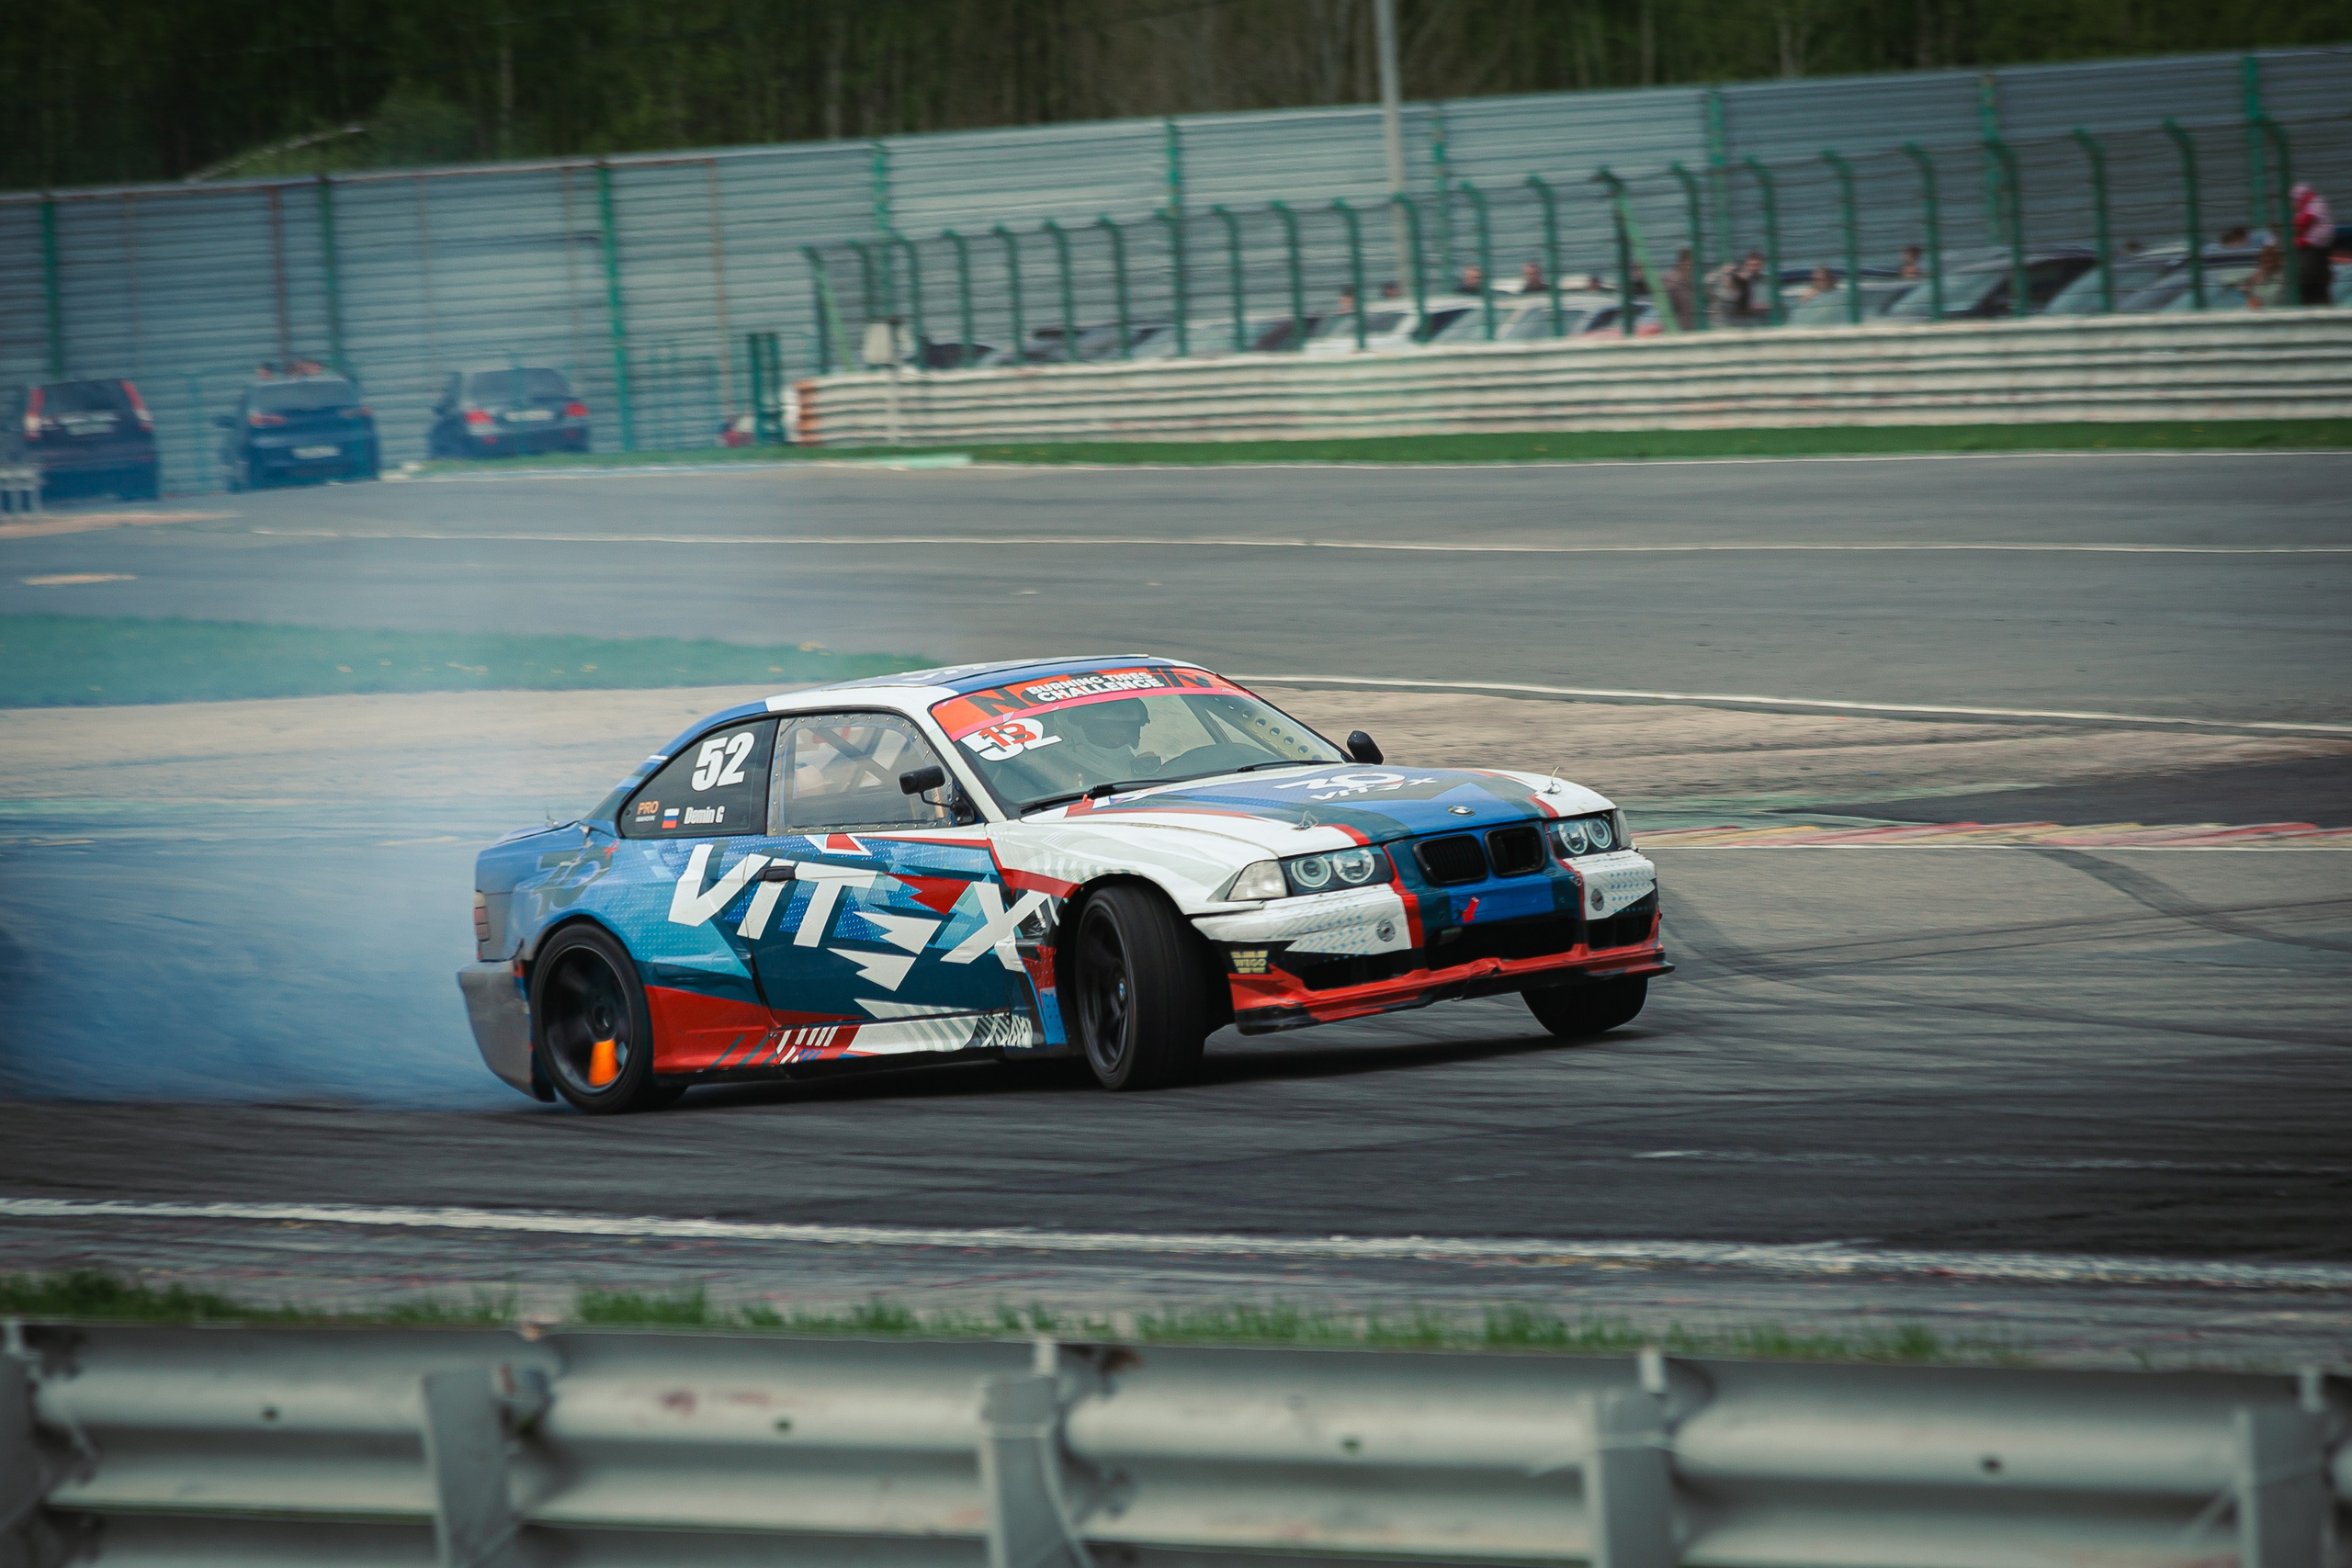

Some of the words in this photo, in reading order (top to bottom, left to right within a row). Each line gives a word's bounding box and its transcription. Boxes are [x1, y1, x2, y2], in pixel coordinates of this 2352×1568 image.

[1025, 676, 1103, 695] BURNING
[1102, 671, 1153, 682] TIRES
[1036, 678, 1165, 702] CHALLENGE
[692, 732, 755, 791] 52
[637, 801, 659, 815] PRO
[684, 807, 714, 825] Demin
[716, 806, 725, 823] G
